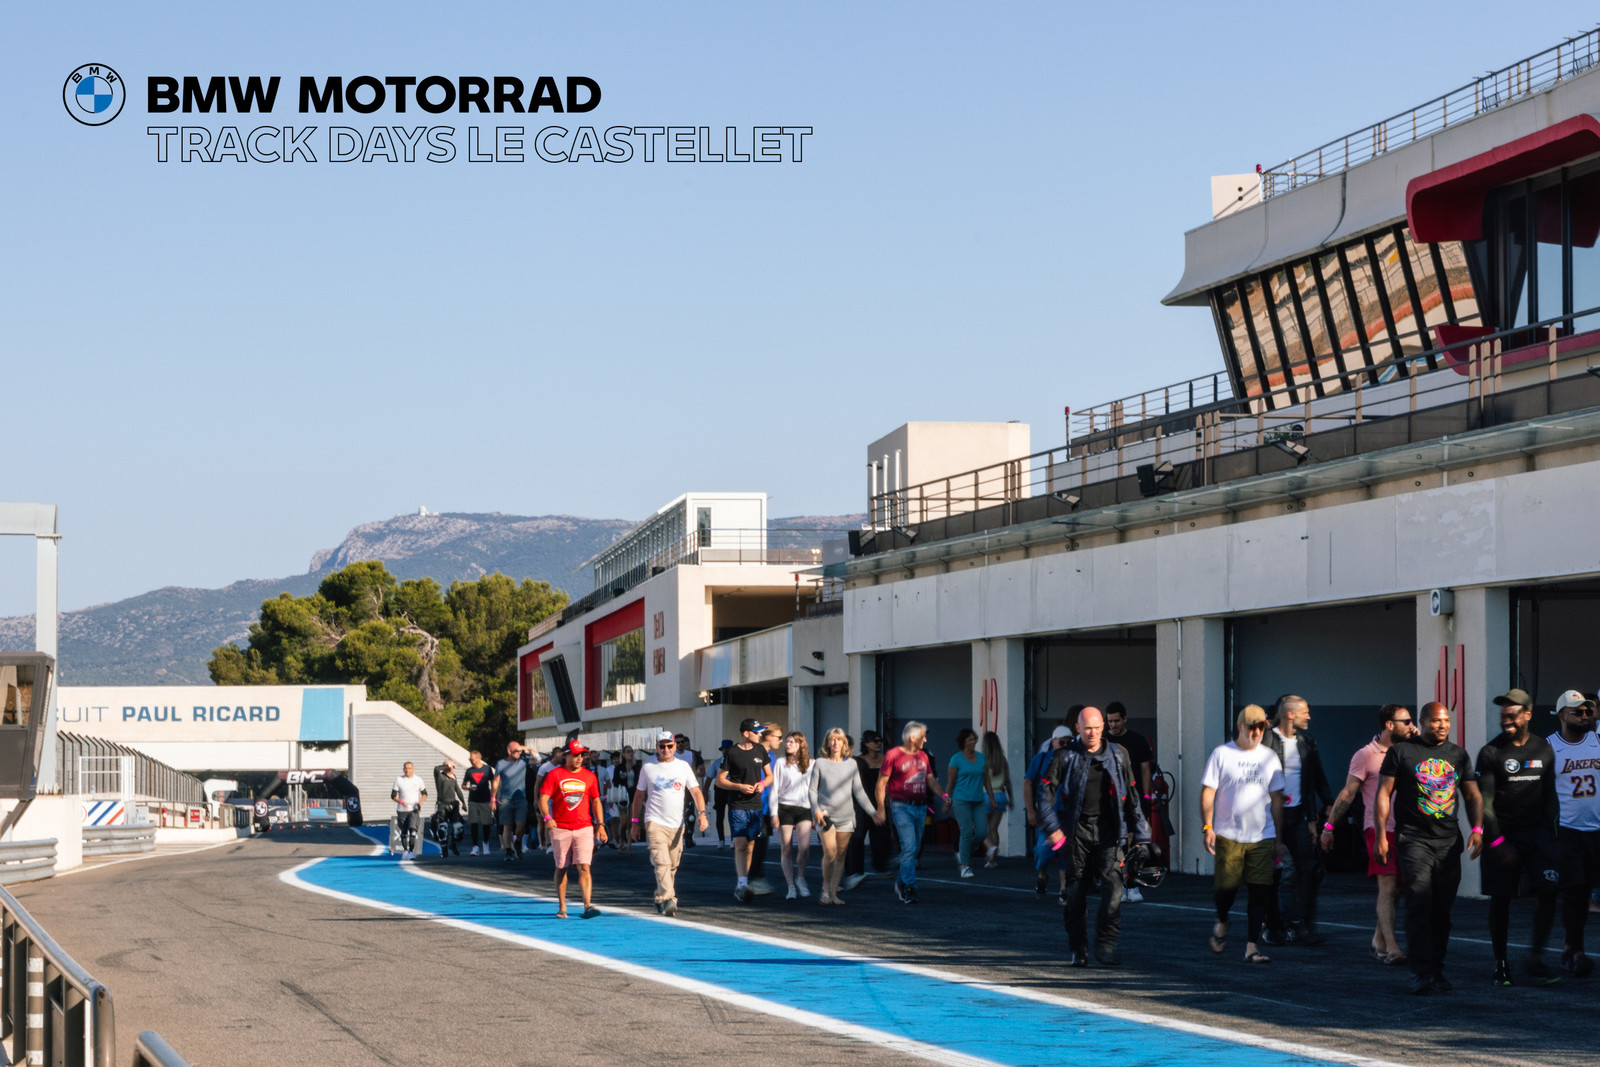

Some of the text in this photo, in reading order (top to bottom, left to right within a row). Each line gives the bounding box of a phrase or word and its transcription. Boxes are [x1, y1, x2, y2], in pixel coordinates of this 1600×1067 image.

[56, 706, 281, 723] UIT PAUL RICARD
[1560, 758, 1600, 775] LAKERS
[286, 770, 326, 784] BMC
[1570, 774, 1597, 798] 23
